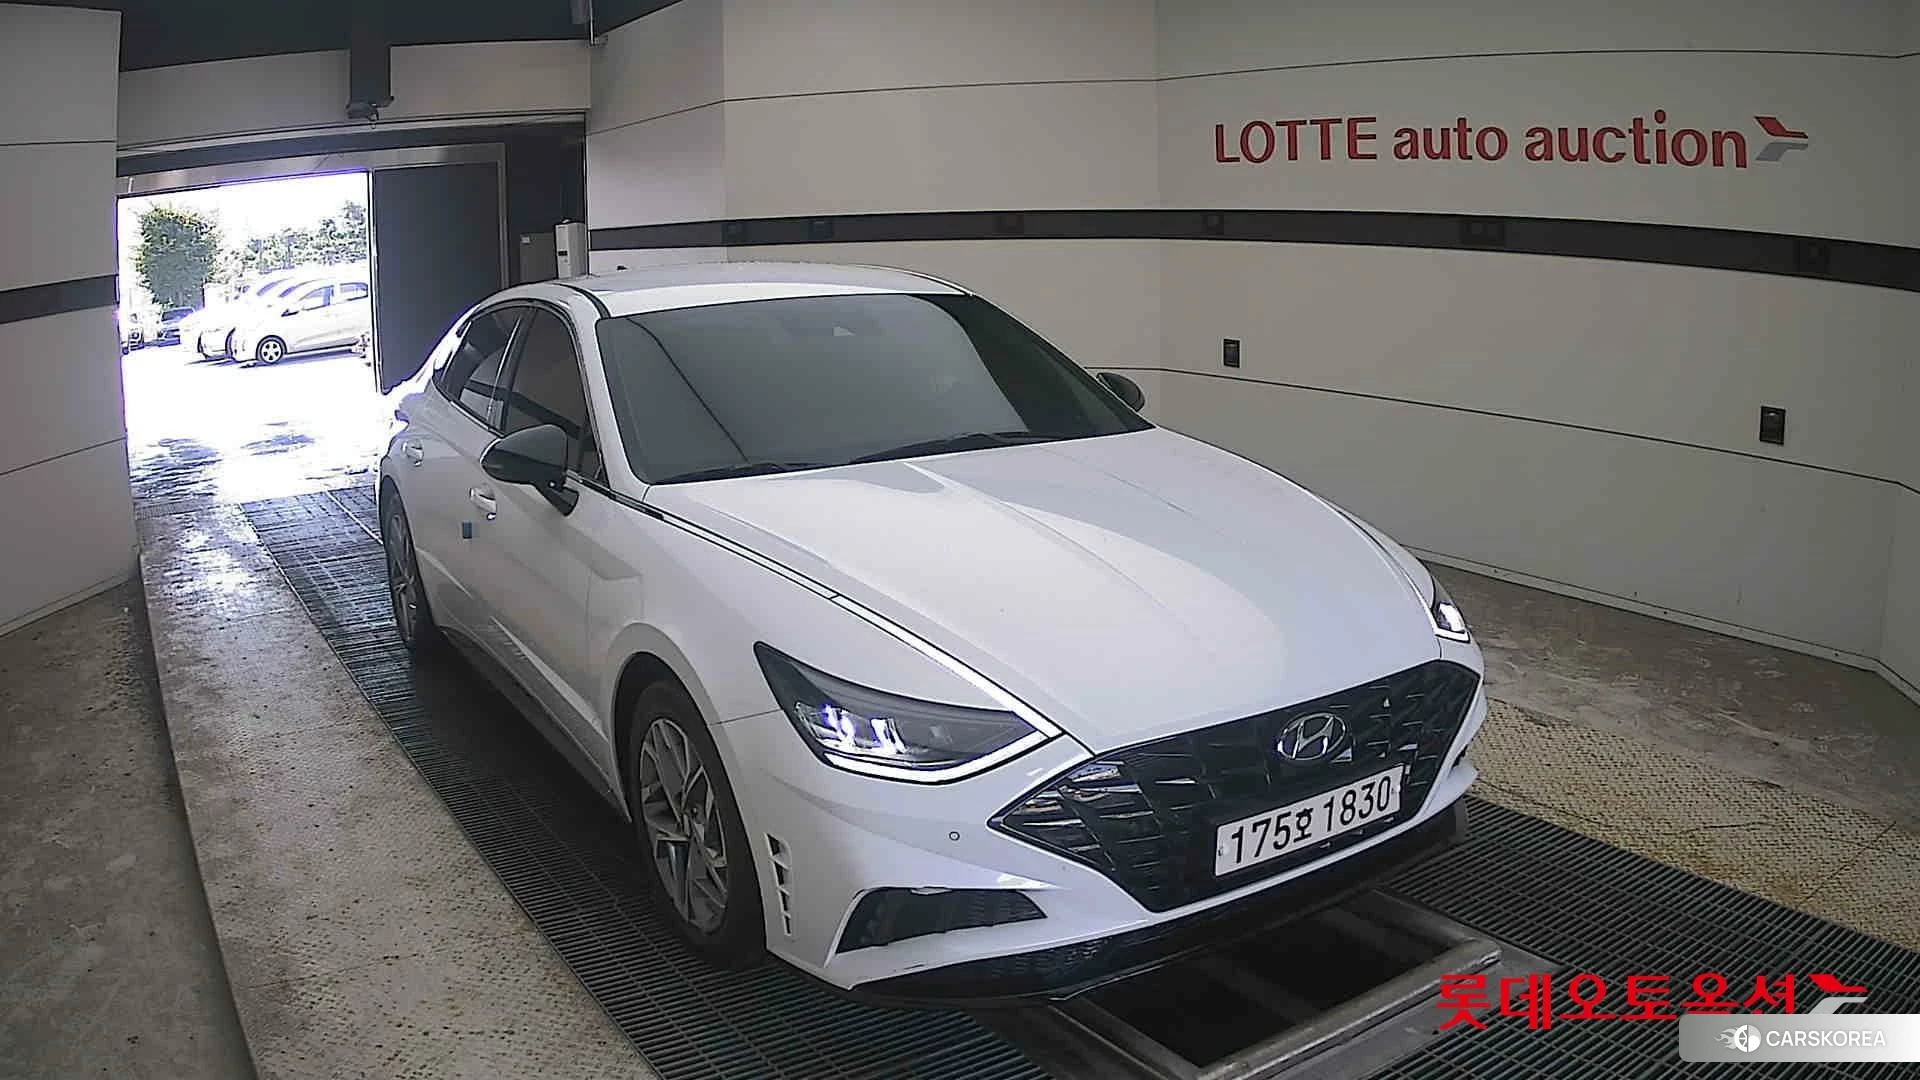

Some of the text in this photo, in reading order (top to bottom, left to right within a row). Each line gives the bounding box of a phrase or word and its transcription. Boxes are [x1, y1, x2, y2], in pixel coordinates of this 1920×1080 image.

[1215, 109, 1748, 168] LOTTE auto auction
[1231, 775, 1392, 864] 175호 1830
